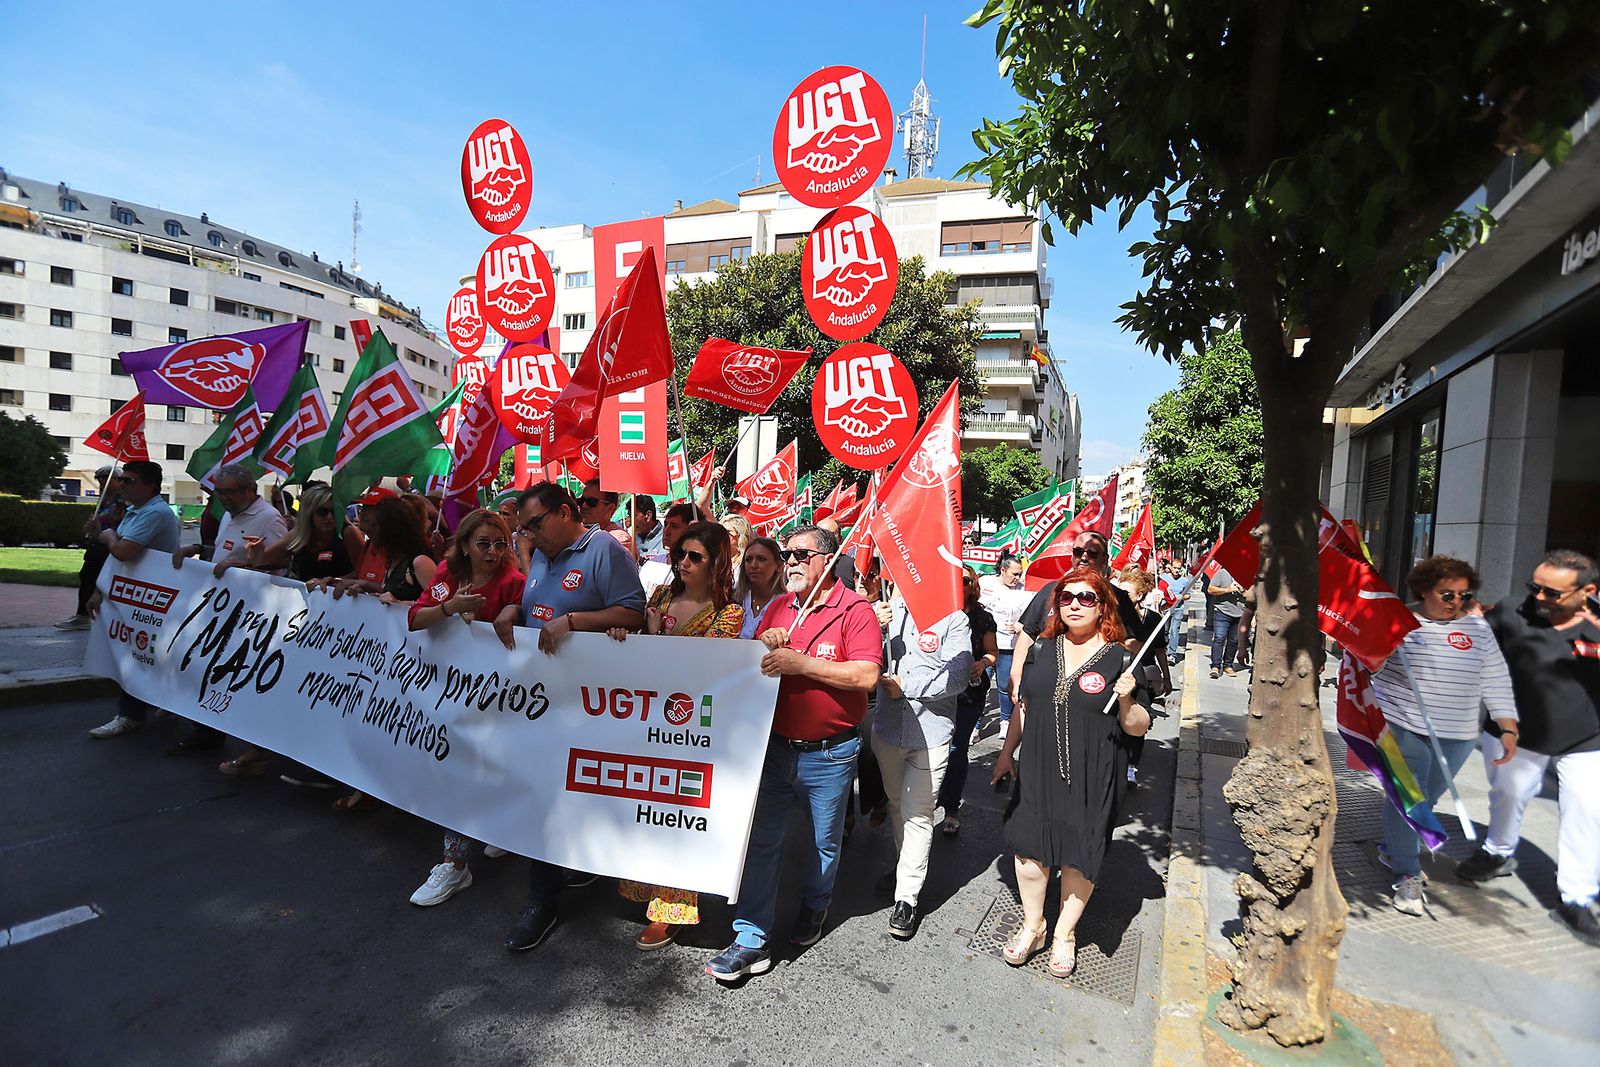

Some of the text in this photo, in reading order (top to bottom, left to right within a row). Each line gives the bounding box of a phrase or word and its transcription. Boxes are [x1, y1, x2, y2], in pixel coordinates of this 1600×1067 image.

[788, 72, 872, 146] UGT
[468, 126, 518, 181] UGT
[805, 166, 869, 194] Andalucía
[485, 203, 522, 223] Andalucía
[812, 212, 880, 278] UGT
[485, 242, 541, 287] UGT
[450, 294, 480, 321] UGT
[827, 301, 877, 326] Andalucía
[499, 312, 542, 332] Andalucía
[457, 361, 487, 385] UGT
[732, 351, 776, 371] UGT
[501, 354, 563, 396] UGT
[825, 353, 898, 402] UGT
[620, 452, 646, 461] HUELVA
[840, 438, 896, 457] Andalucía
[565, 572, 582, 586] UGT
[132, 609, 163, 627] Huelva
[239, 610, 262, 631] DE
[532, 605, 545, 616] UGT
[109, 618, 135, 646] UGT
[132, 649, 155, 666] Huelva
[180, 599, 285, 703] MAYO
[283, 609, 332, 649] Subir
[386, 637, 437, 696] bajar
[435, 664, 551, 721] precios
[200, 689, 233, 714] 2023
[580, 685, 659, 722] UGT
[298, 670, 451, 762] repartir beneficios
[647, 726, 712, 749] Huelva
[636, 804, 708, 833] Huelva
